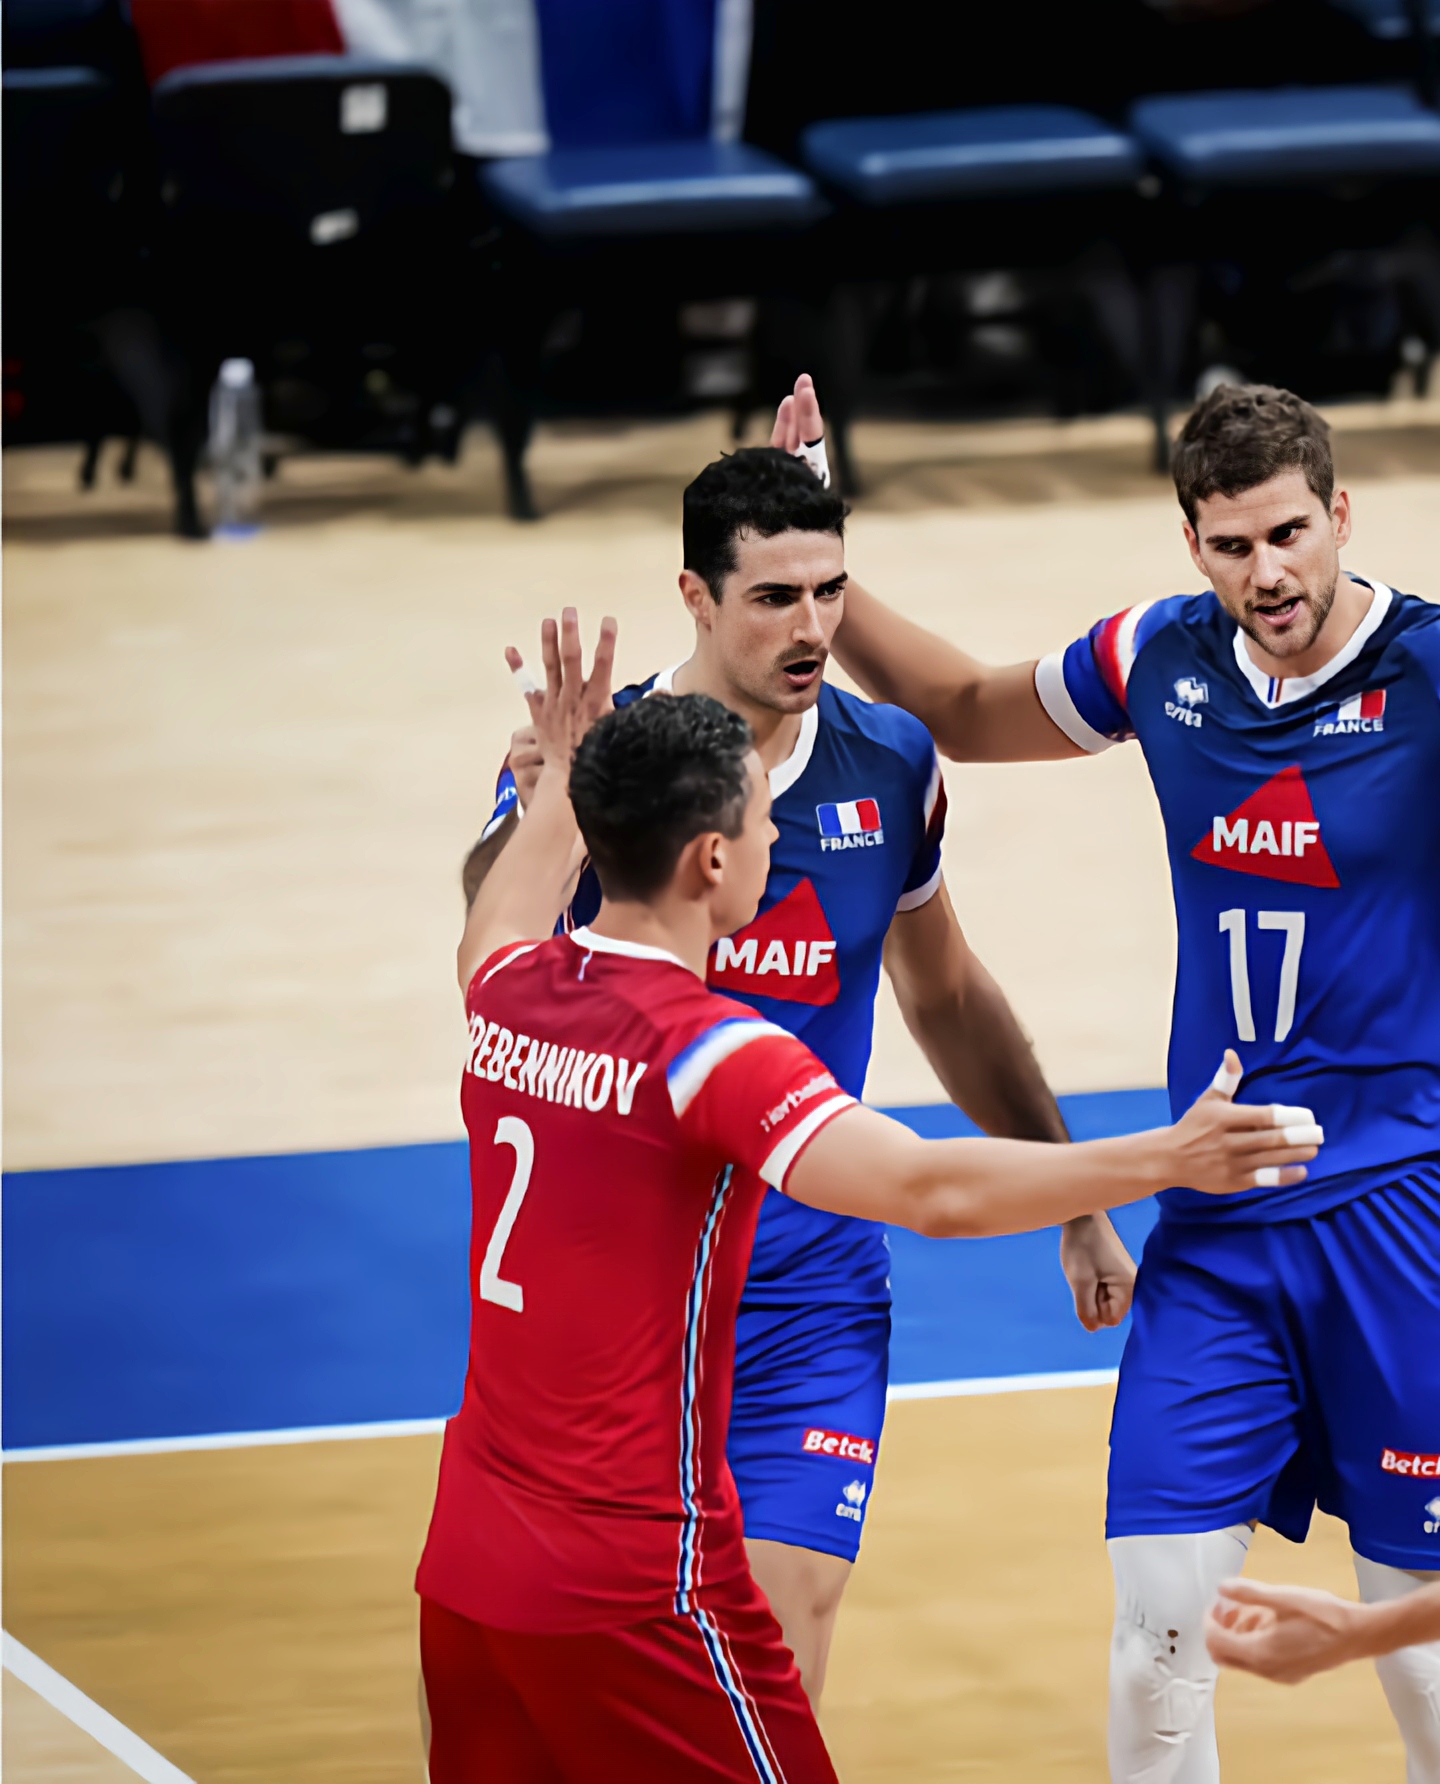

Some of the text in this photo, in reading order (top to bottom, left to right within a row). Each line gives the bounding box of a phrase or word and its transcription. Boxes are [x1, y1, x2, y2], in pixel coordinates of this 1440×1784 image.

[1312, 717, 1385, 738] FRANCE
[820, 829, 885, 852] FRANCE
[1212, 815, 1320, 858] MAIF
[714, 936, 837, 977] MAIF
[1219, 908, 1306, 1043] 17
[466, 1010, 648, 1116] REBENNIKOV
[479, 1115, 536, 1314] 2
